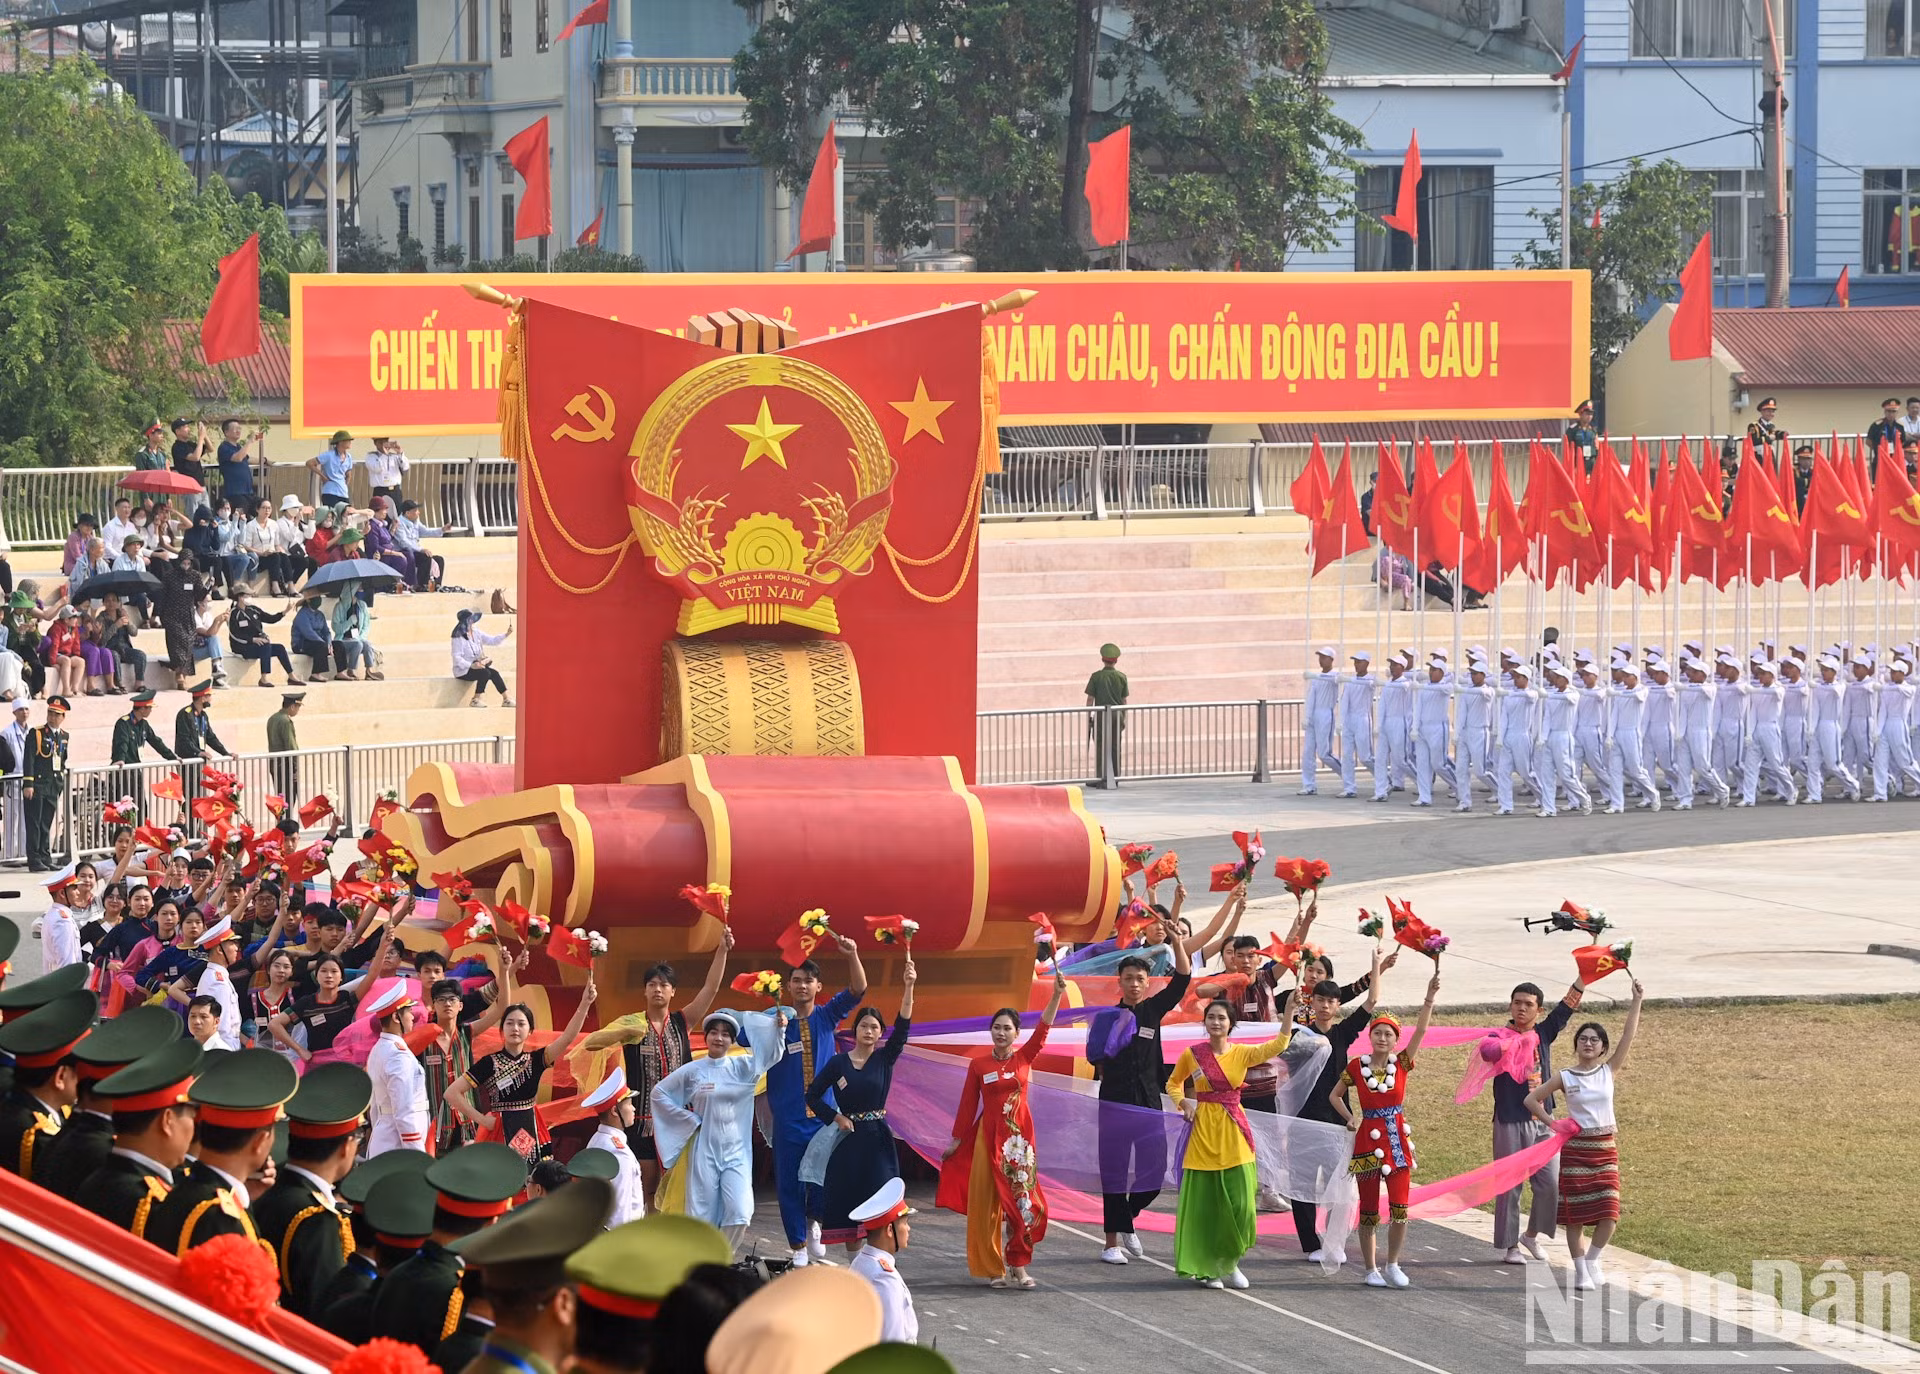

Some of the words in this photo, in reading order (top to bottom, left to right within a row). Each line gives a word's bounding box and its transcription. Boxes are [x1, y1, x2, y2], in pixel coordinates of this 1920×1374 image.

[370, 309, 459, 392] CHIẾN
[984, 312, 1057, 382] NĂM
[1067, 311, 1159, 388] CHÂU,
[1168, 303, 1252, 381] CHẤN
[1260, 311, 1346, 393] ĐỘNG
[1355, 323, 1410, 392] ĐỊA
[1419, 301, 1499, 379] CẦU!
[725, 583, 763, 601] VIỆT
[767, 585, 805, 602] NAM
